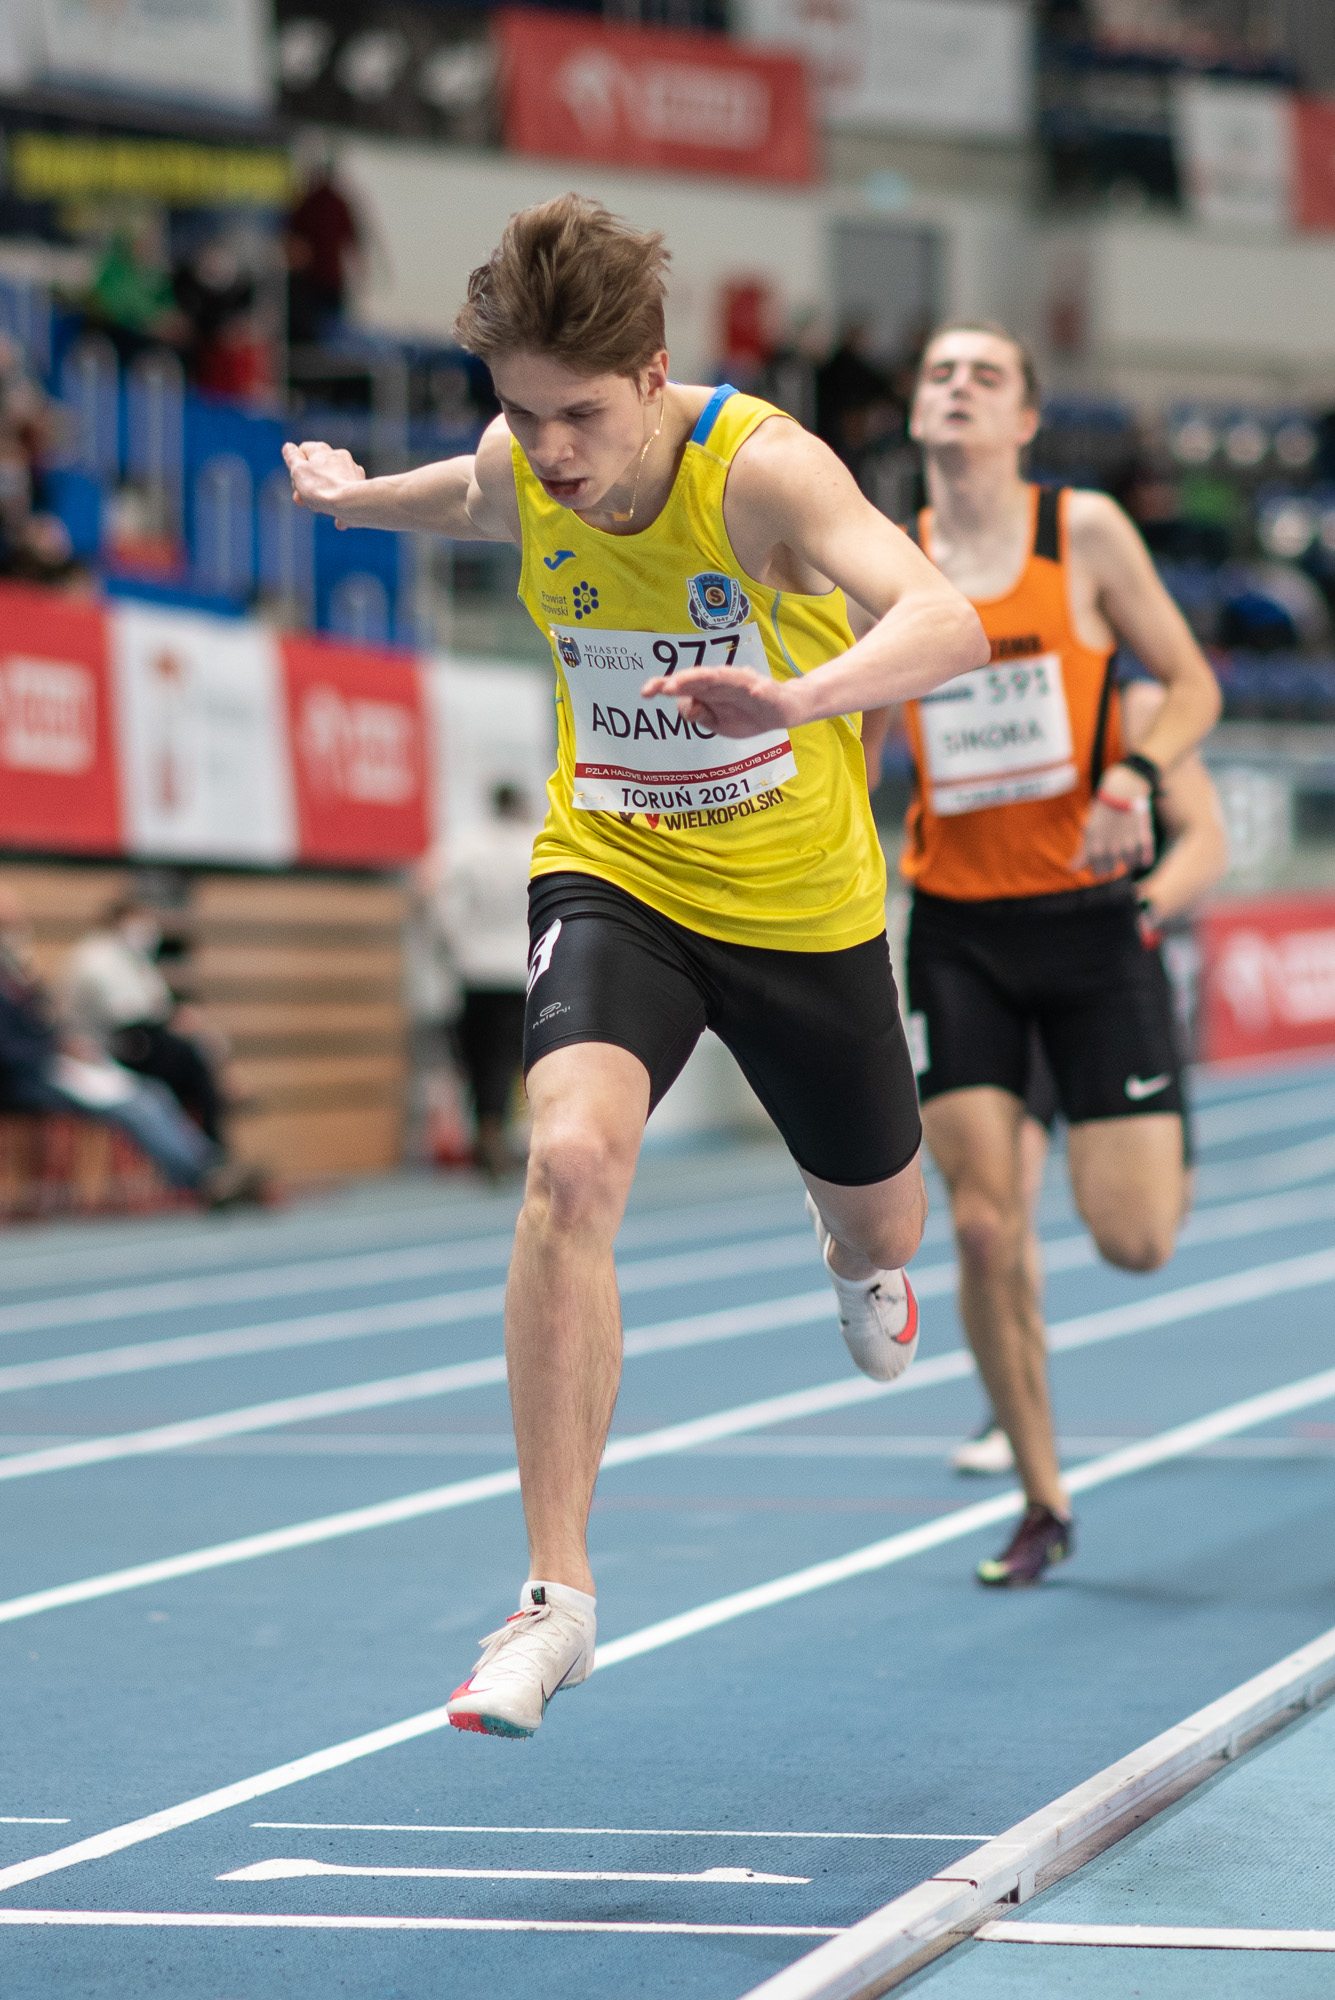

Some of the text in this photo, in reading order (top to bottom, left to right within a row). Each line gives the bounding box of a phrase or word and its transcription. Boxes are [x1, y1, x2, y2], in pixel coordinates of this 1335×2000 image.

[541, 590, 568, 605] Powiat
[710, 589, 722, 603] S
[584, 644, 628, 655] MIASTO
[584, 653, 644, 670] TORUŃ
[652, 634, 740, 677] 977
[585, 747, 783, 782] PZLA HALOWE MISTRZOSTWA POLSKI U18 U20
[621, 778, 752, 810] TORUŃ 2021
[664, 788, 784, 831] WIELKOPOLSKI
